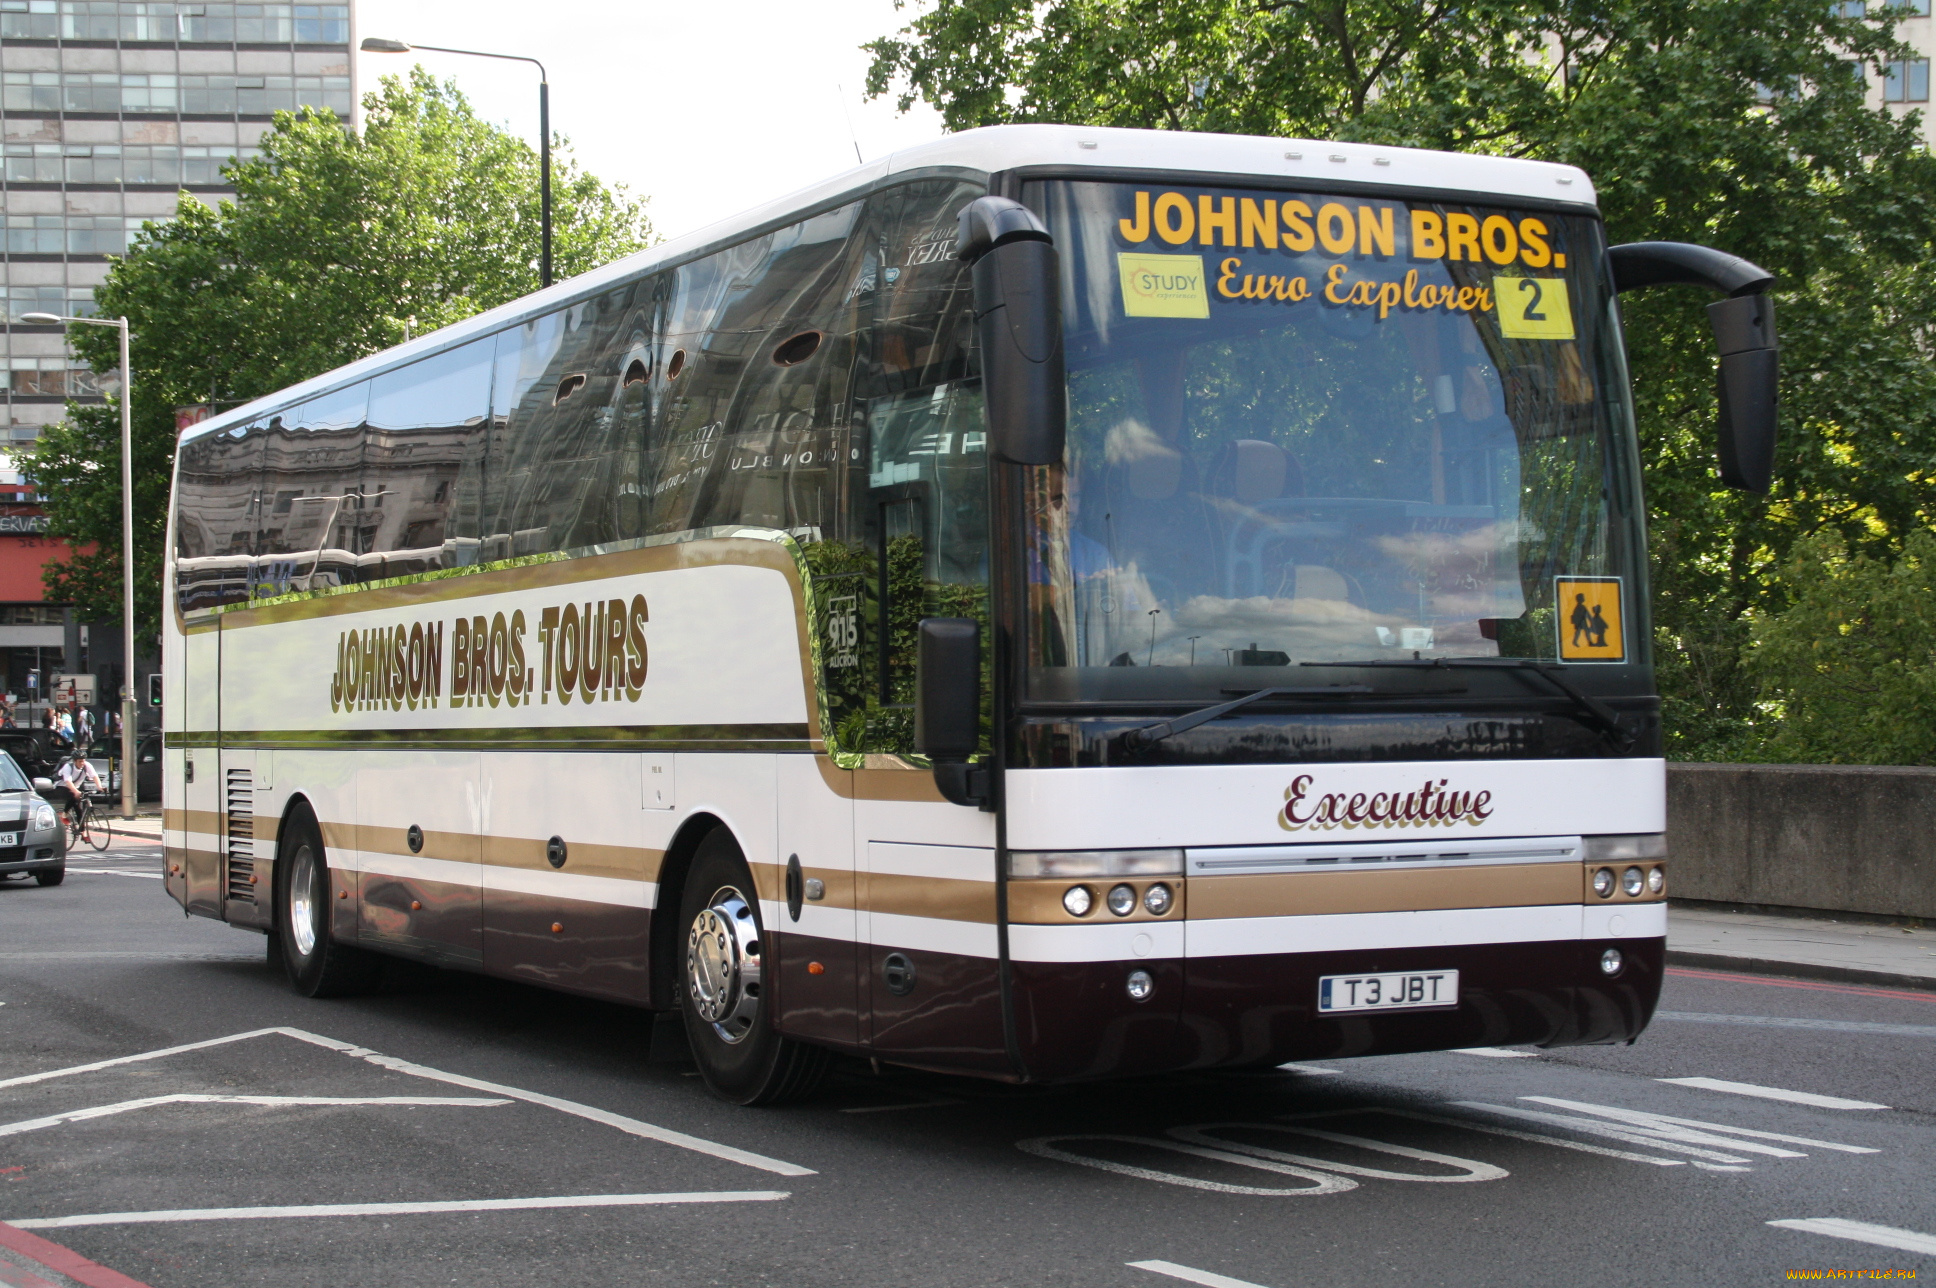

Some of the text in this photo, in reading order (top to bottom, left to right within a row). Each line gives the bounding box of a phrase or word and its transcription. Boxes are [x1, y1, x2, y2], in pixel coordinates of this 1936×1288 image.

[1118, 190, 1566, 269] JOHNSON BROS.
[1142, 274, 1198, 291] STUDY
[1216, 257, 1494, 319] Euro Explorer
[1518, 278, 1548, 322] 2
[331, 594, 650, 714] JOHNSON BROS. TOURS
[829, 615, 858, 648] 915
[1279, 774, 1495, 832] Executive
[1344, 975, 1444, 1006] T3 JBT
